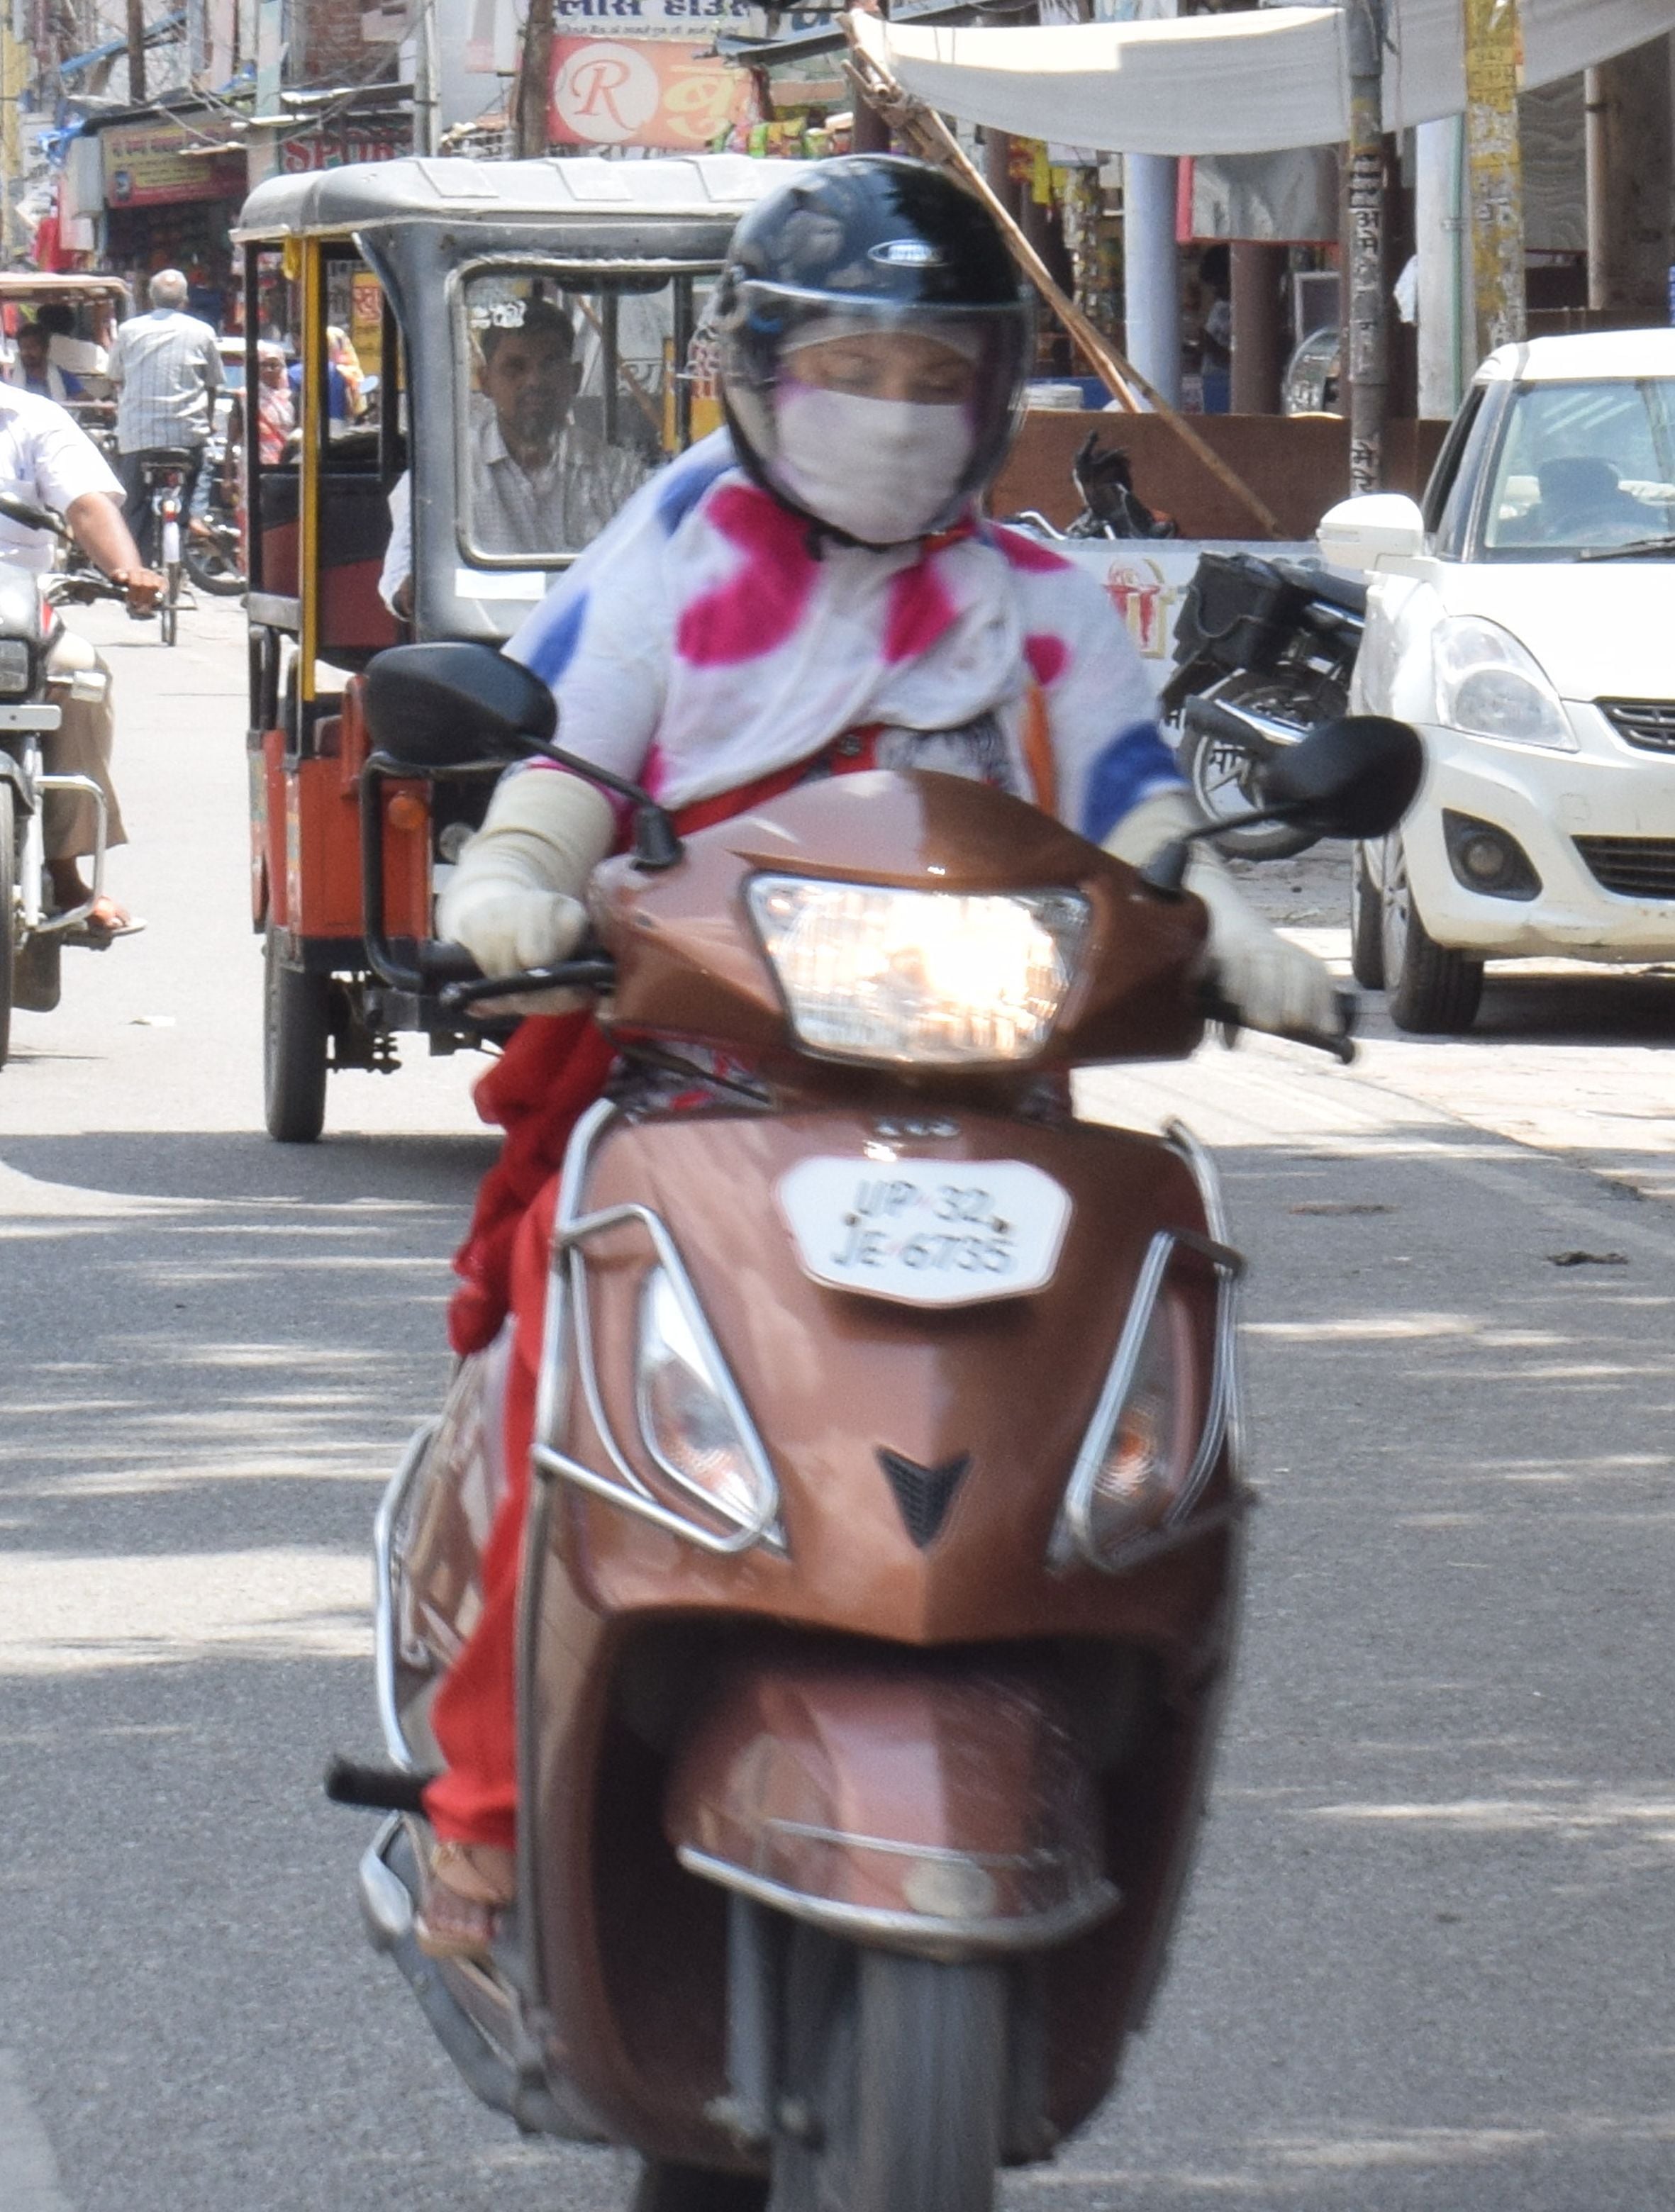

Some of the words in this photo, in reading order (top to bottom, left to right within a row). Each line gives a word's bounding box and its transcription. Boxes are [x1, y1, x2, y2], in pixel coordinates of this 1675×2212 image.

[569, 59, 638, 132] R
[855, 1178, 918, 1217] UP
[933, 1183, 996, 1224] 32
[830, 1229, 888, 1267] JE
